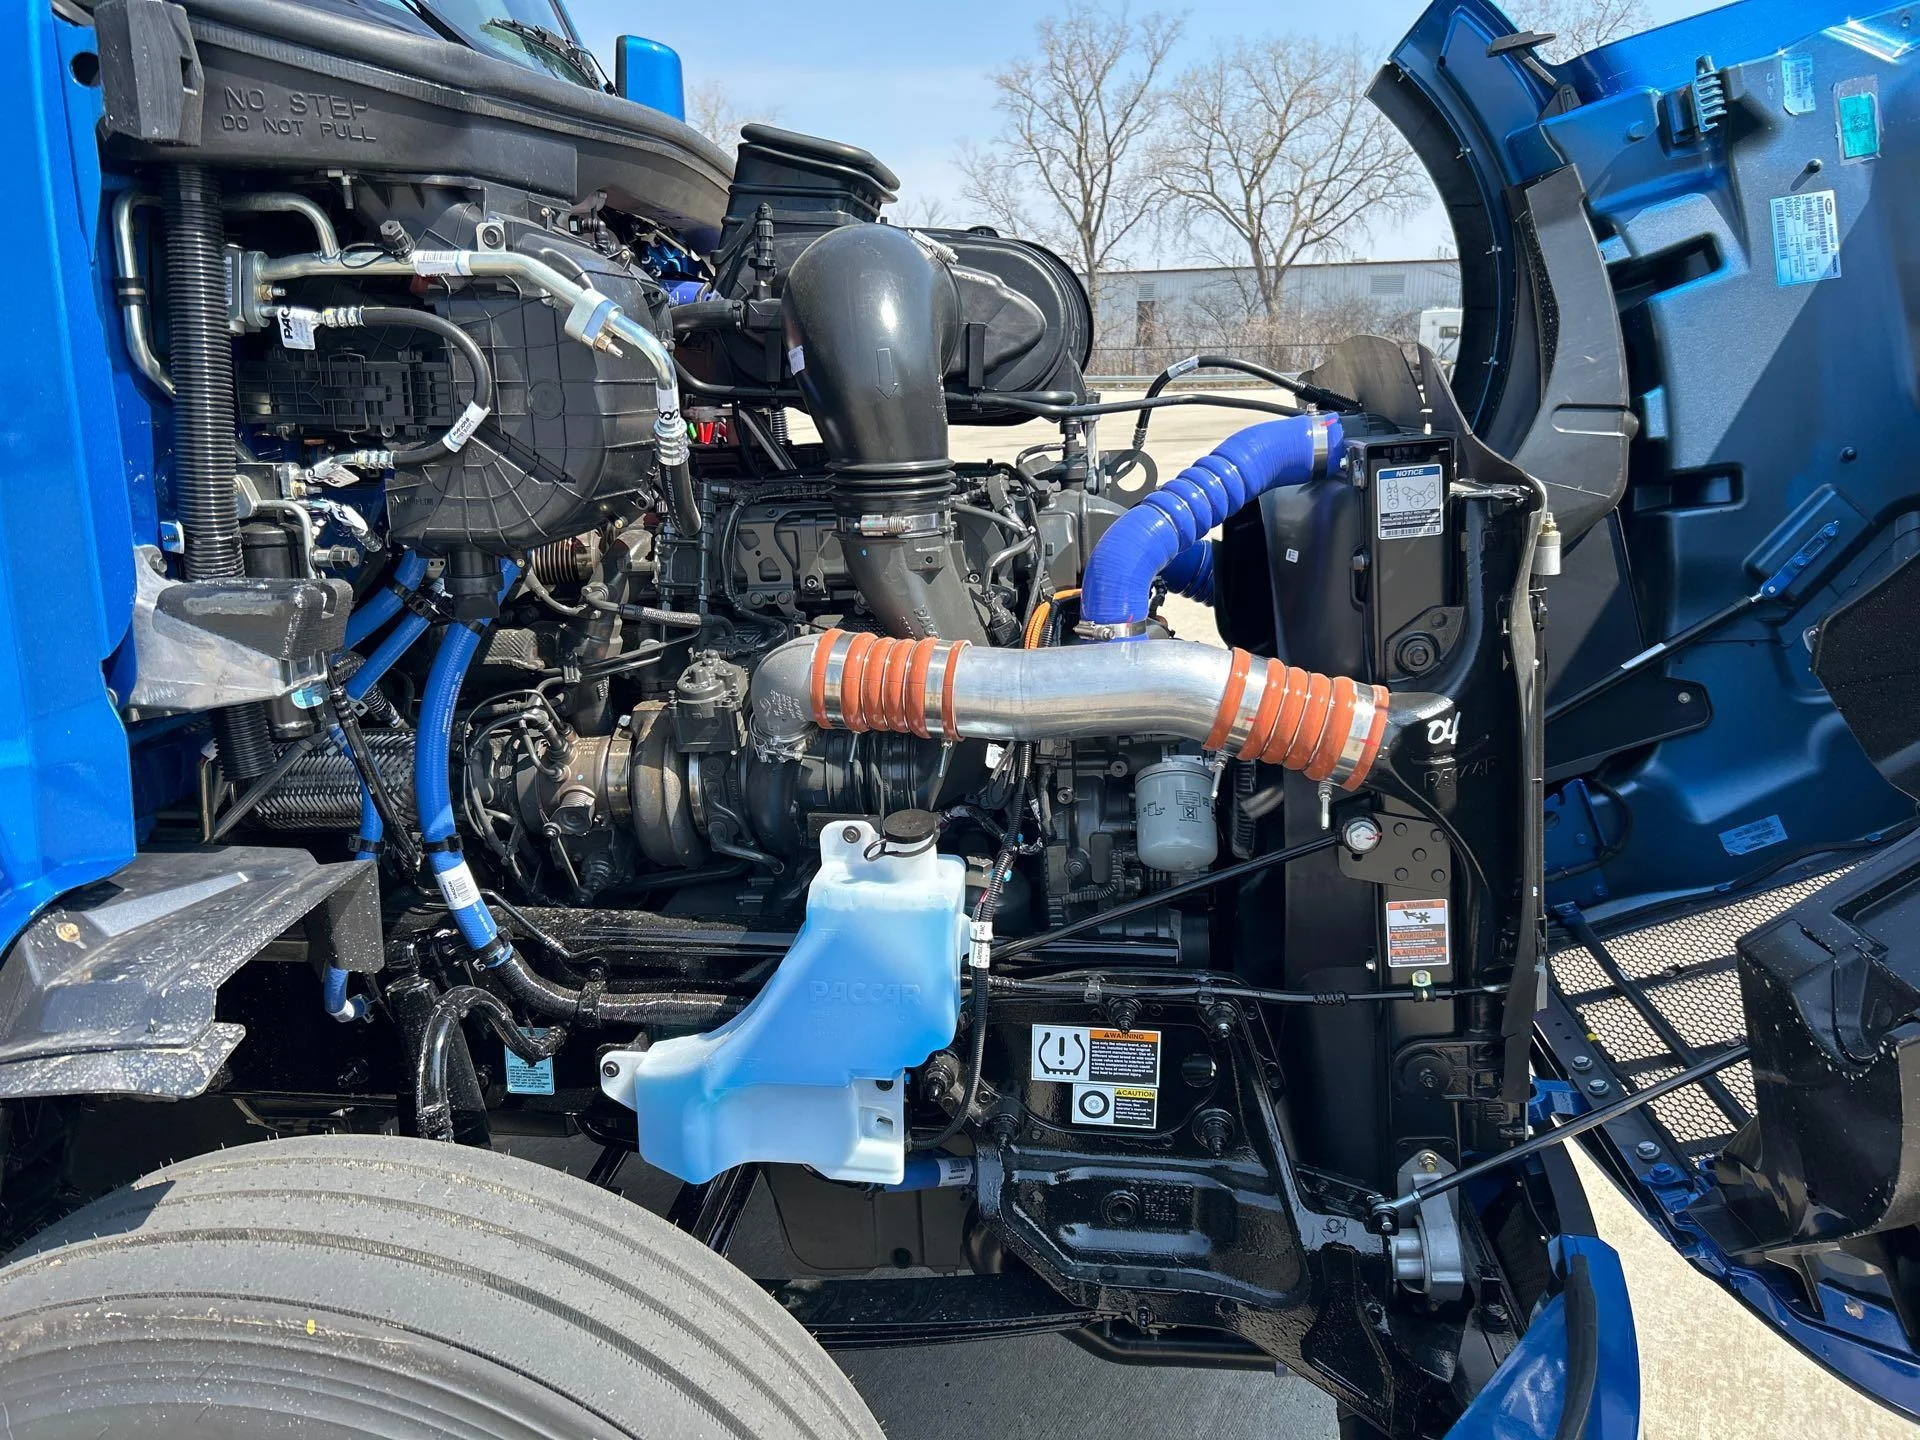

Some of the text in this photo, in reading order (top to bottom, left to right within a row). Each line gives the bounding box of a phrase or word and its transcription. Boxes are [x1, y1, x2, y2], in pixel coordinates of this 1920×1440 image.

[224, 86, 369, 120] NO STEP
[222, 114, 376, 142] DO NOT PULL
[808, 980, 921, 1005] PACCAR
